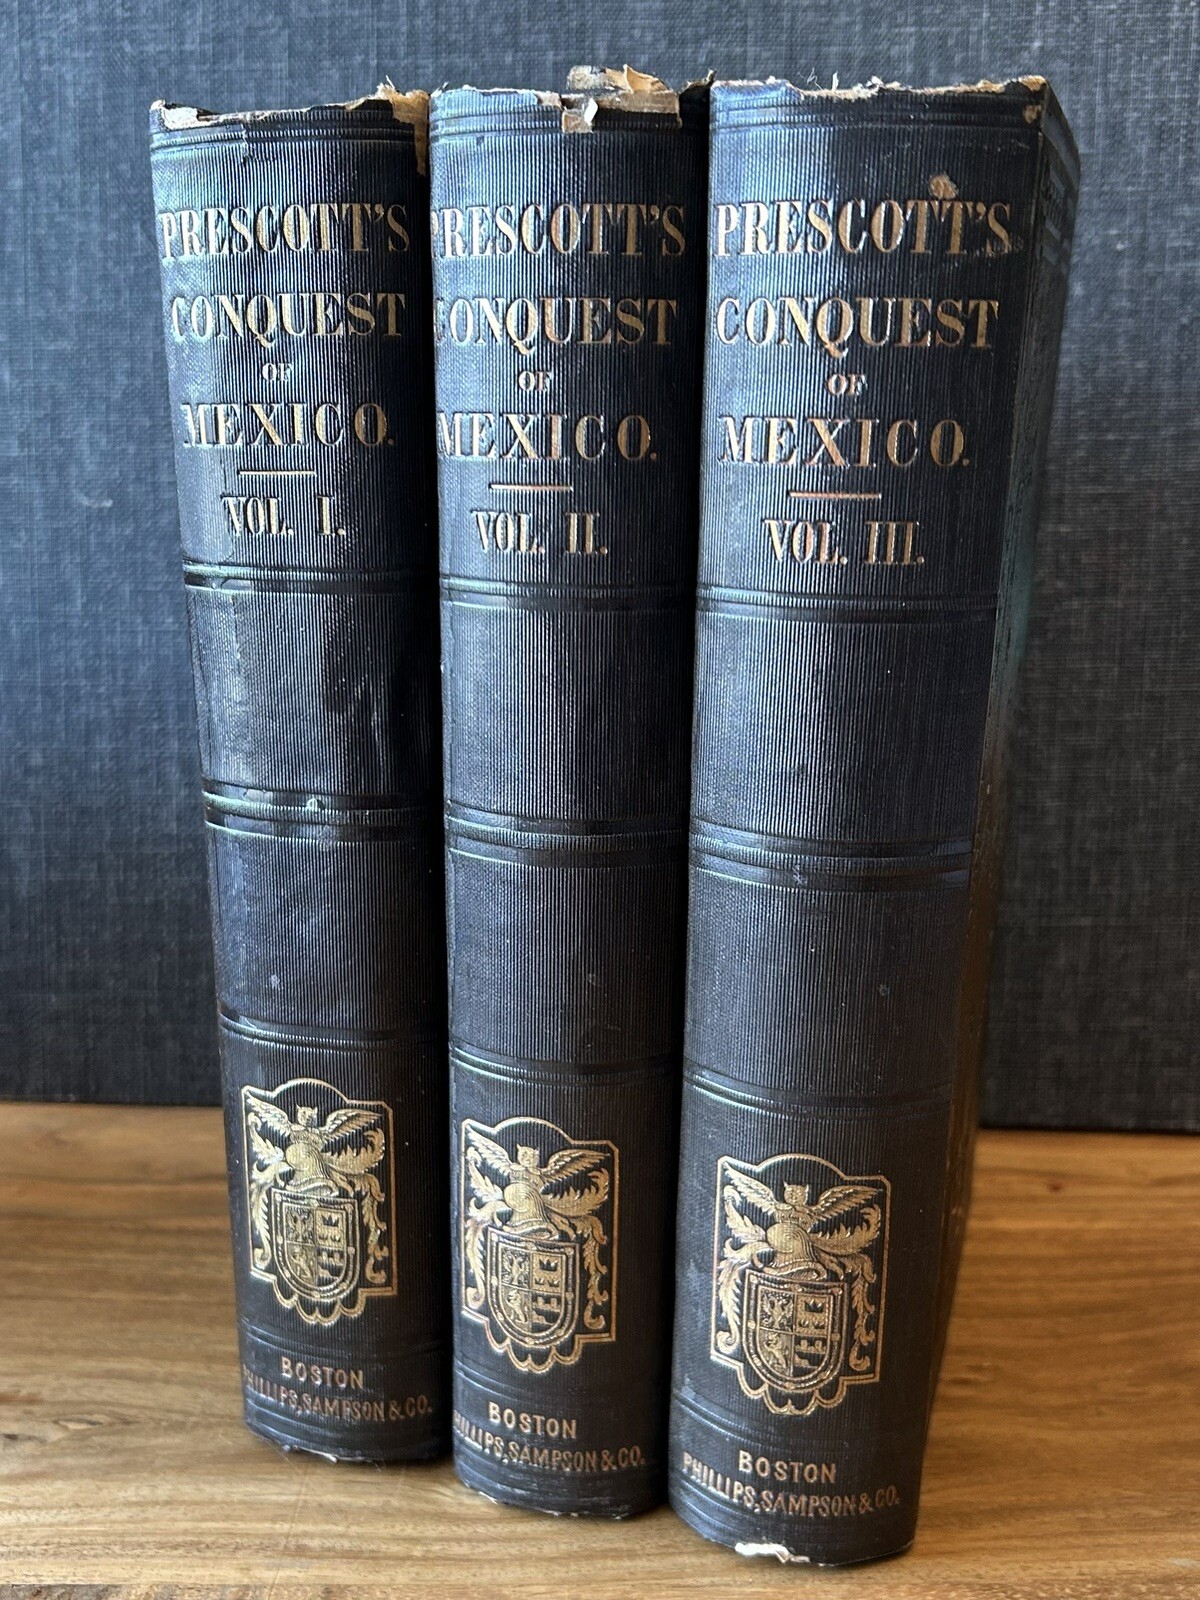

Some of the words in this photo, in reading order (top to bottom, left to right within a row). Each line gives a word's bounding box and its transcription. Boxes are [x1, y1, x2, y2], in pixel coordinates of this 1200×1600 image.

[158, 203, 410, 260] PRESCOTT'S
[714, 199, 1011, 257] PRESCOTT'S
[171, 293, 405, 348] CONQUEST
[434, 297, 677, 355] CONQUEST
[717, 297, 999, 357] CONQUEST
[262, 362, 292, 381] OF
[518, 370, 551, 391] OF
[827, 373, 867, 396] OF
[182, 403, 395, 447] MEXICO.
[437, 413, 658, 461] MEXICO.
[719, 415, 970, 467] MEXICO.
[222, 495, 294, 536] VOL.
[316, 495, 346, 536] I.
[471, 510, 546, 554] VOL.
[565, 512, 608, 554] II.
[764, 519, 848, 565] VOL.
[864, 520, 925, 565] III.
[281, 1356, 364, 1389] BOSTON
[488, 1401, 577, 1439] BOSTON
[739, 1450, 836, 1483] BOSTON
